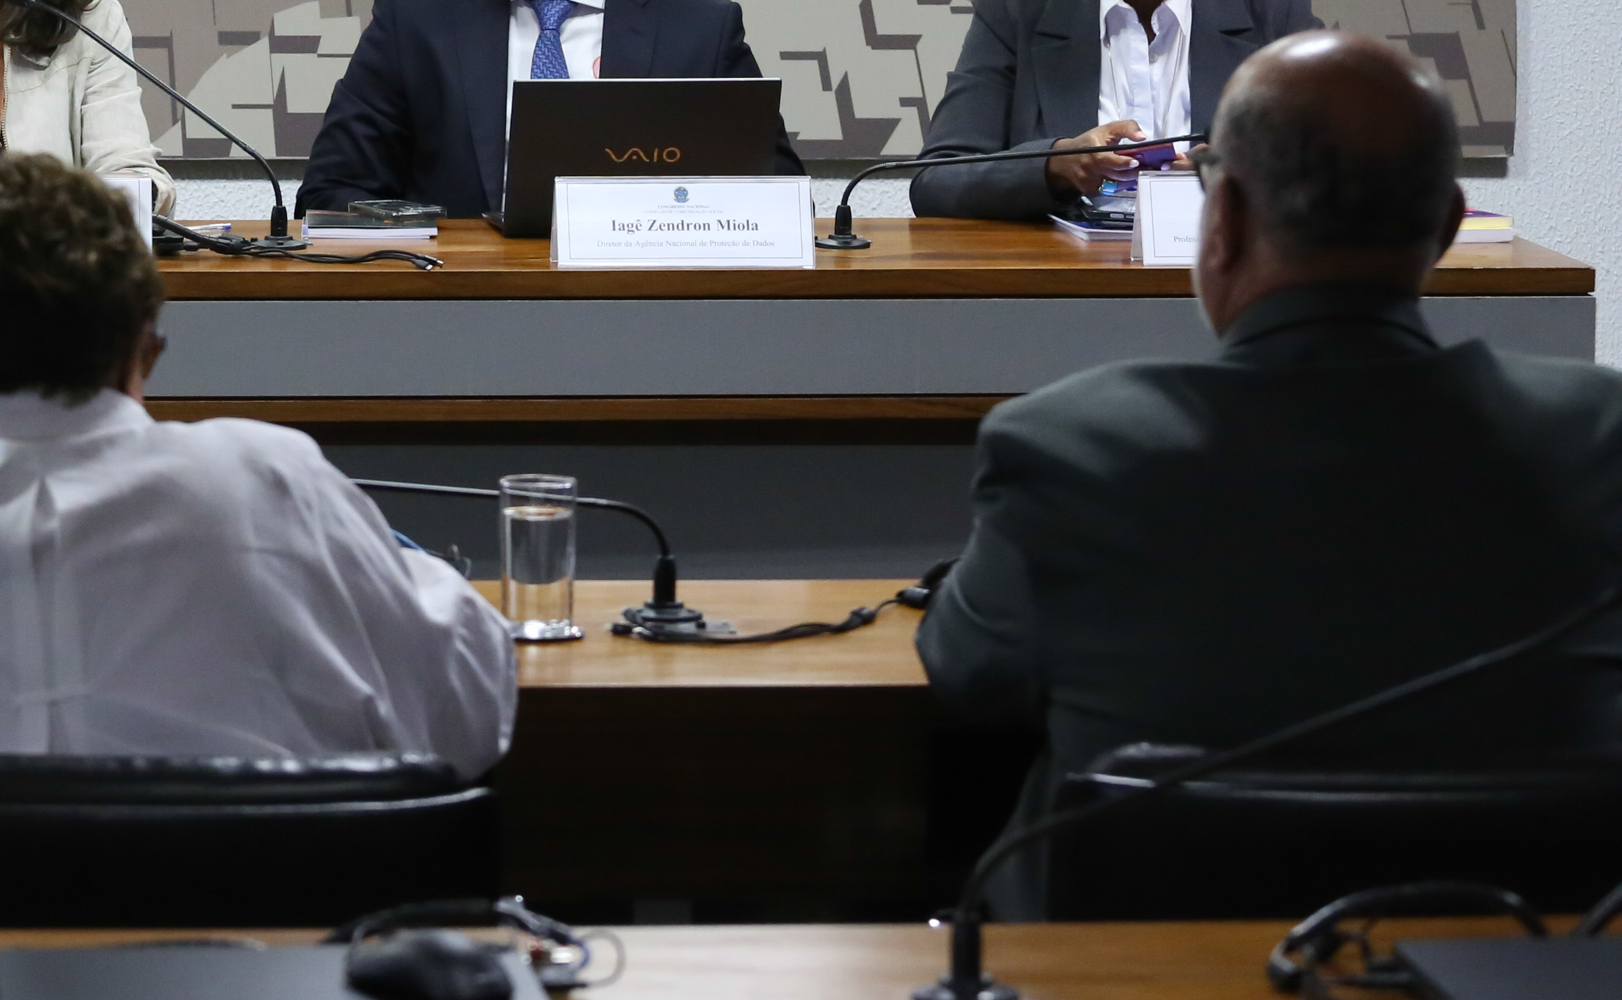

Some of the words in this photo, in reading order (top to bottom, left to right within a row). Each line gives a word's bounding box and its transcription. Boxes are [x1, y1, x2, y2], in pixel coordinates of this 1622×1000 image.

[604, 147, 681, 163] VAIO
[611, 219, 643, 234] Iagê
[647, 219, 711, 231] Zendron
[716, 219, 759, 231] Miola
[634, 240, 664, 249] Agência
[709, 240, 740, 248] Proteção
